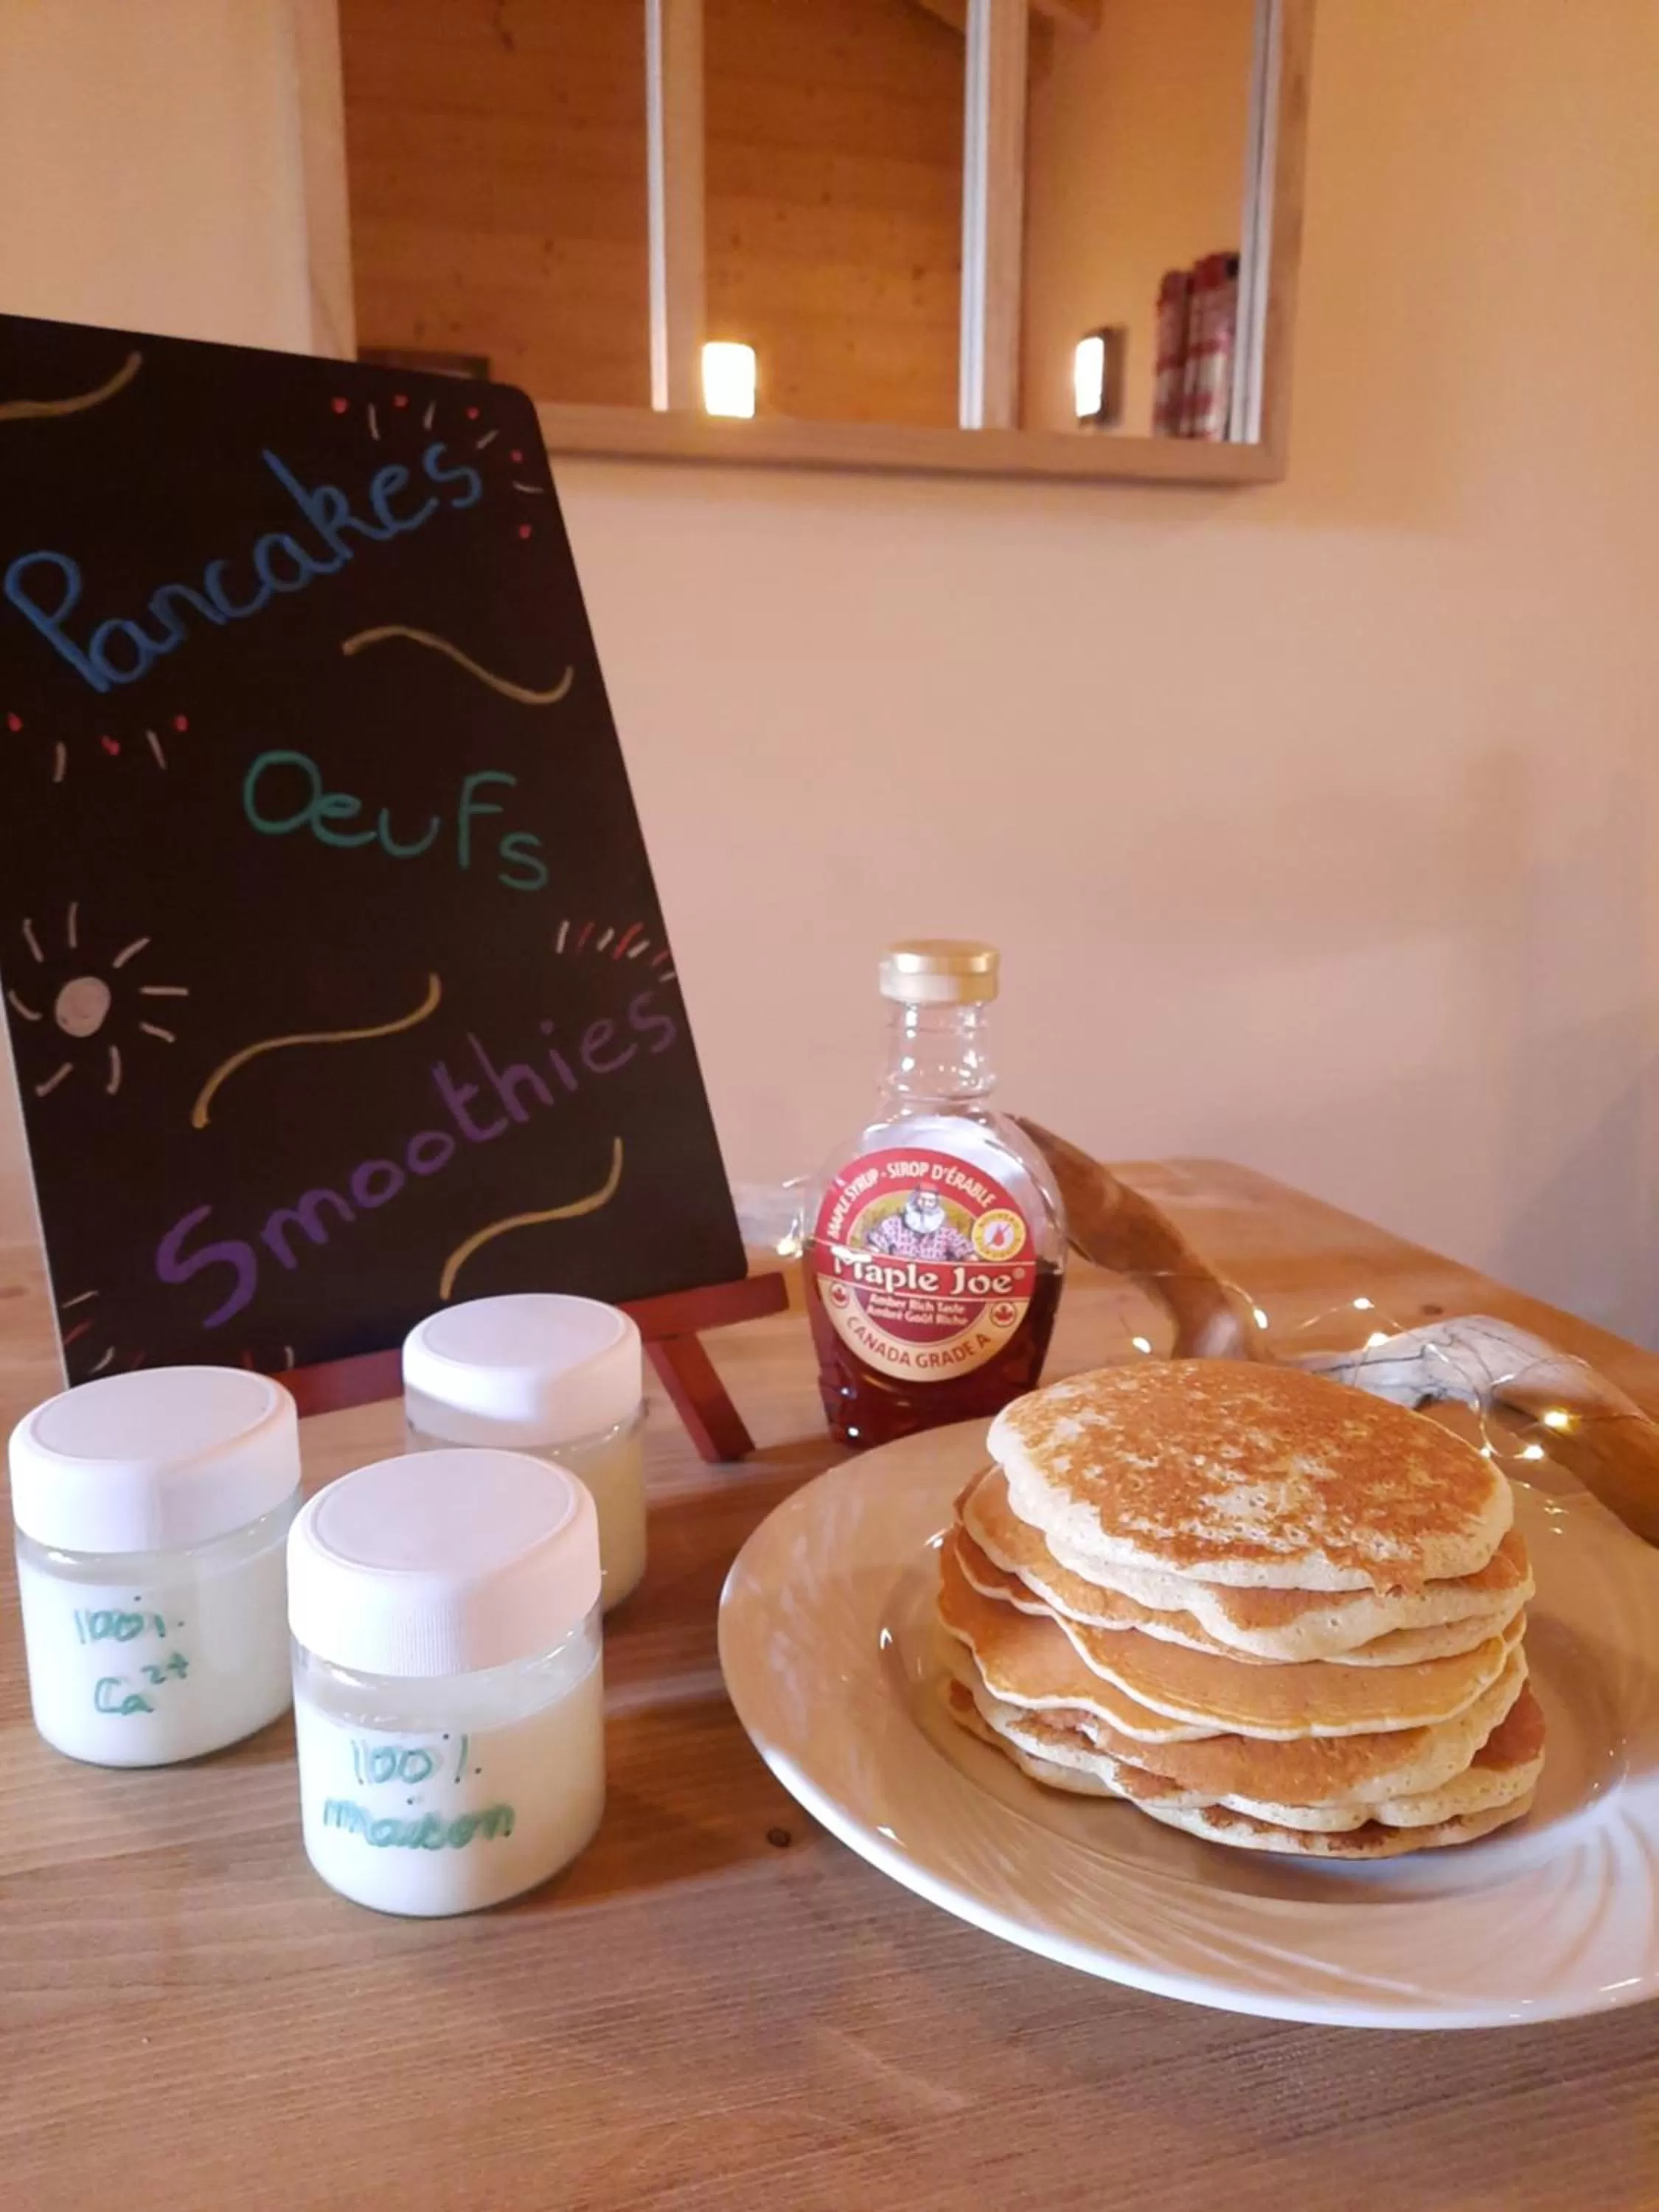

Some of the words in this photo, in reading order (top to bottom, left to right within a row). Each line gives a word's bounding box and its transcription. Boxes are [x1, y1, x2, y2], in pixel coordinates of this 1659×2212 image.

[4, 442, 483, 693] Pancakes
[156, 990, 676, 1327] Smoothies
[827, 1194, 852, 1240] MAPLE
[844, 1168, 879, 1202] SYRUP
[886, 1161, 930, 1179] SIROP
[932, 1164, 995, 1208] D'ÉRABLE
[831, 1246, 939, 1293] Maple
[847, 1315, 911, 1367] CANADA
[915, 1341, 975, 1369] GRADE
[975, 1332, 992, 1349] A
